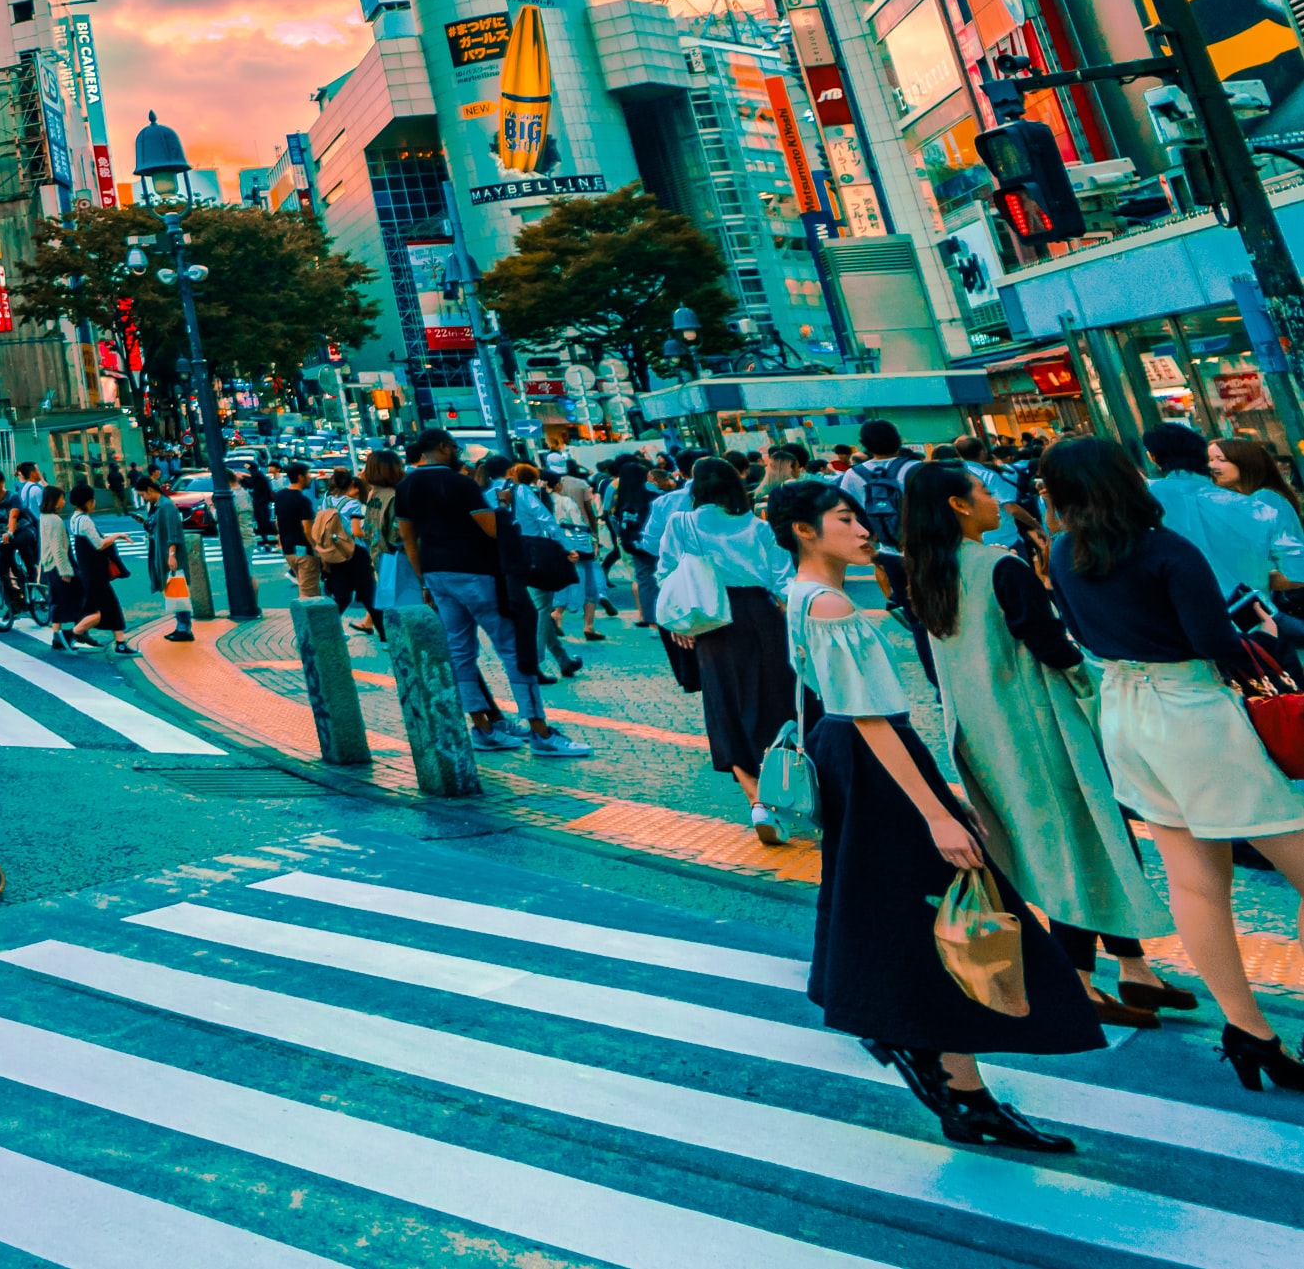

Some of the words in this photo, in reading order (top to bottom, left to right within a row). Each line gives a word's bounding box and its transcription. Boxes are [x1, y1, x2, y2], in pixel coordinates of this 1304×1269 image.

[76, 22, 90, 44] BIC
[448, 16, 507, 38] #まつげに
[459, 28, 510, 49] ガールズ
[463, 46, 500, 62] パワー
[79, 46, 100, 104] CAMERA
[465, 103, 492, 116] NEW
[505, 118, 542, 143] BIG
[844, 137, 861, 166] フルーツ
[471, 176, 604, 201] MAYBELLINE
[792, 149, 816, 212] Matsumoto
